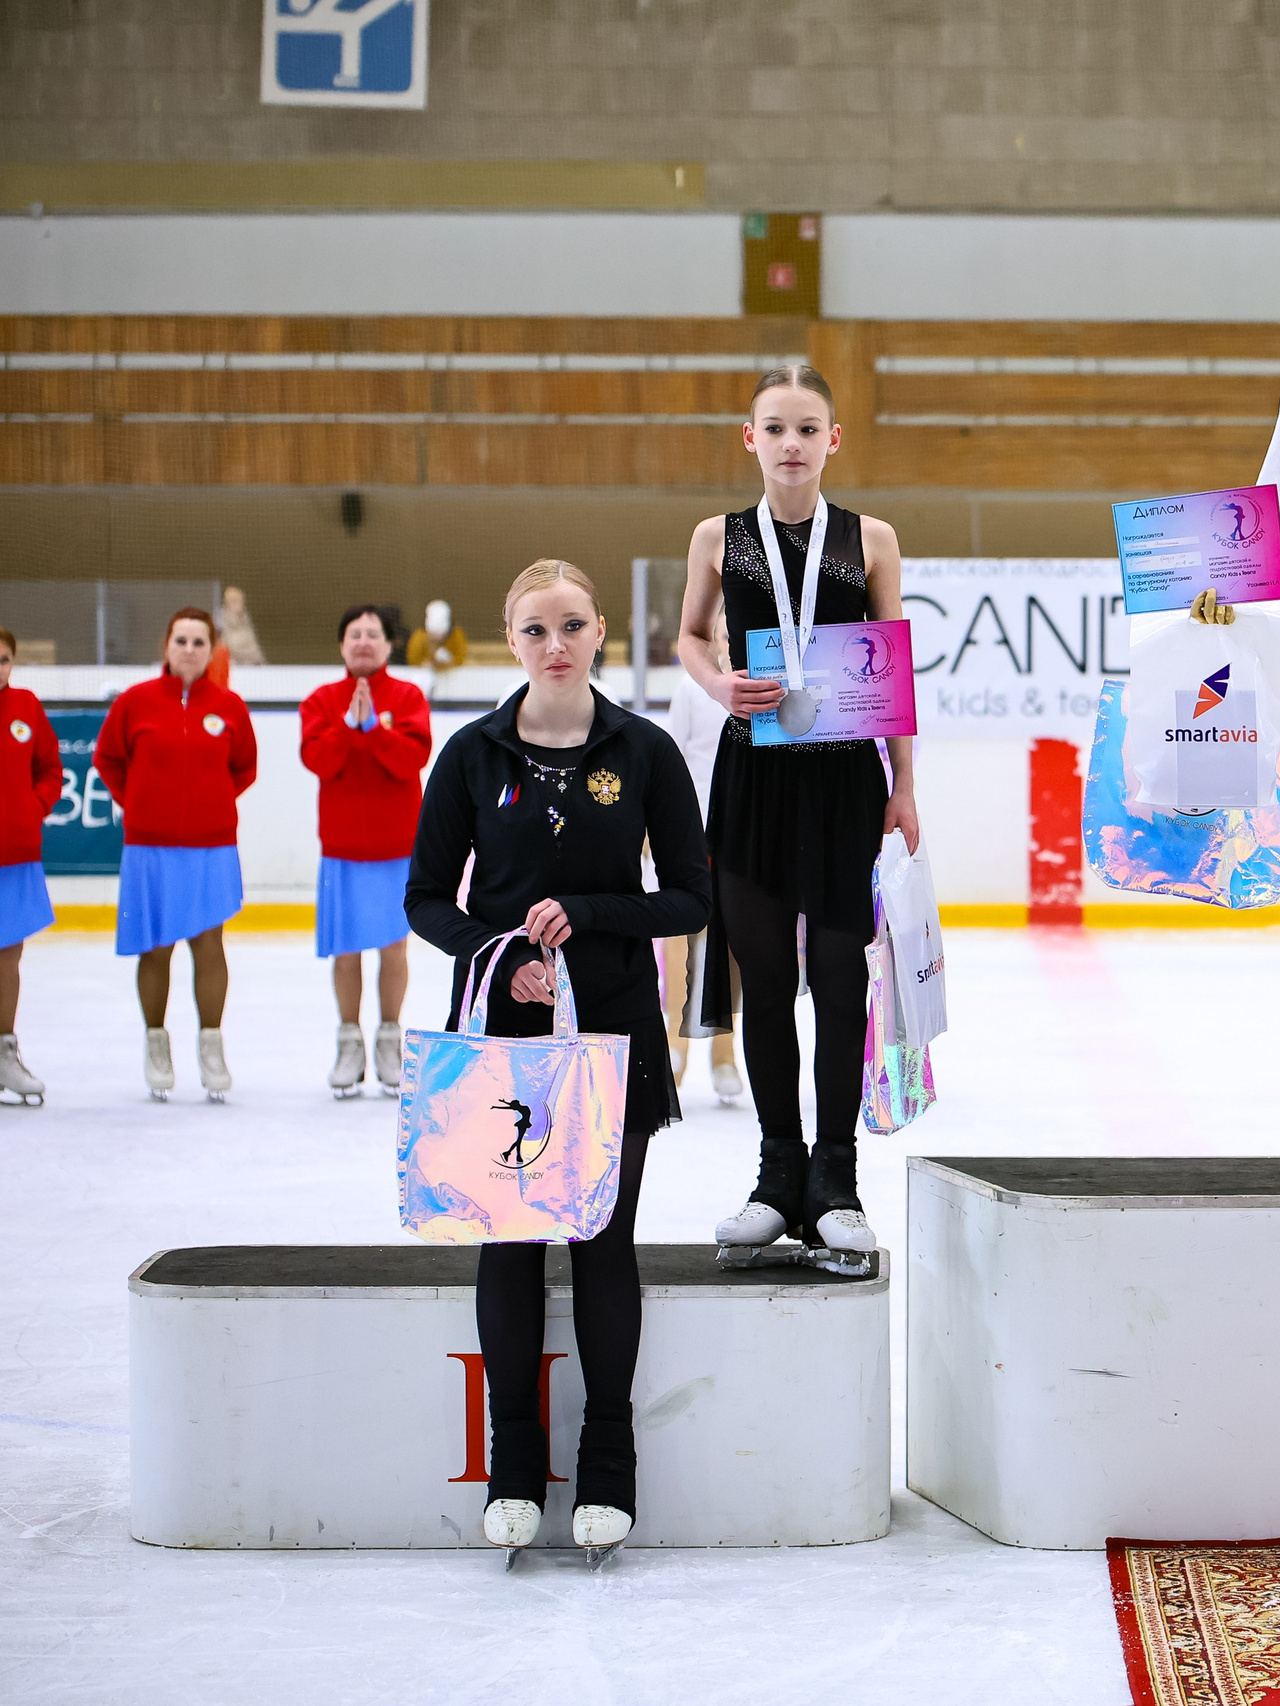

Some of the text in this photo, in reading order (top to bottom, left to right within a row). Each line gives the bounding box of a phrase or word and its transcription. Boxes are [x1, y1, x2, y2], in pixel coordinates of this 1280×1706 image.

[1212, 528, 1266, 550] КУБОК CANDY
[900, 595, 1130, 674] CAND
[842, 663, 897, 684] КУБОК CANDY
[1165, 725, 1258, 743] smartavia
[1165, 817, 1219, 832] КУБОК CANDY
[489, 1172, 544, 1180] КУБОК CANDY
